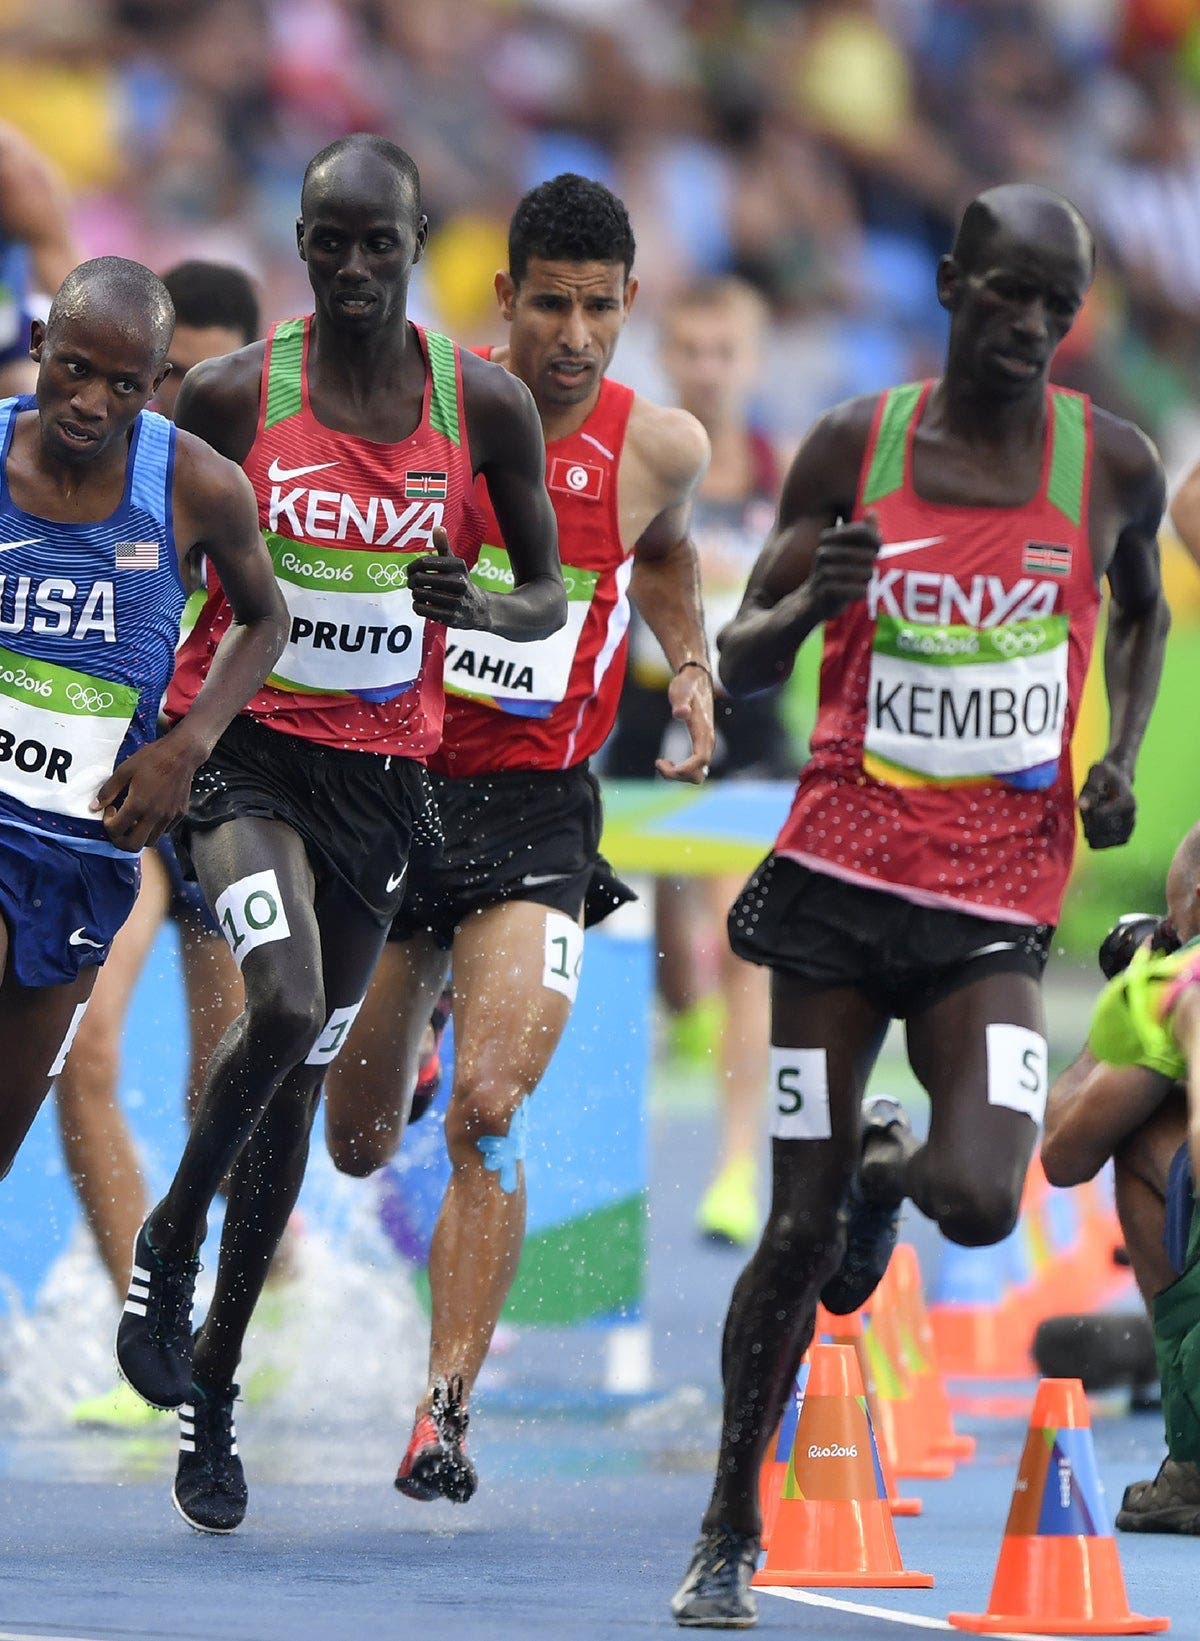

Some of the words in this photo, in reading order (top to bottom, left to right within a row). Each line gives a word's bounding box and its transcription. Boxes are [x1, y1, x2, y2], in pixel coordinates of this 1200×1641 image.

[269, 486, 445, 547] KENYA
[282, 553, 354, 582] Rio2016
[867, 568, 1059, 630] KENYA
[290, 616, 413, 655] PRUTO
[875, 679, 1061, 739] KEMBOI
[222, 890, 278, 954] 10
[778, 1068, 803, 1114] 5
[808, 1444, 858, 1458] Rio2016
